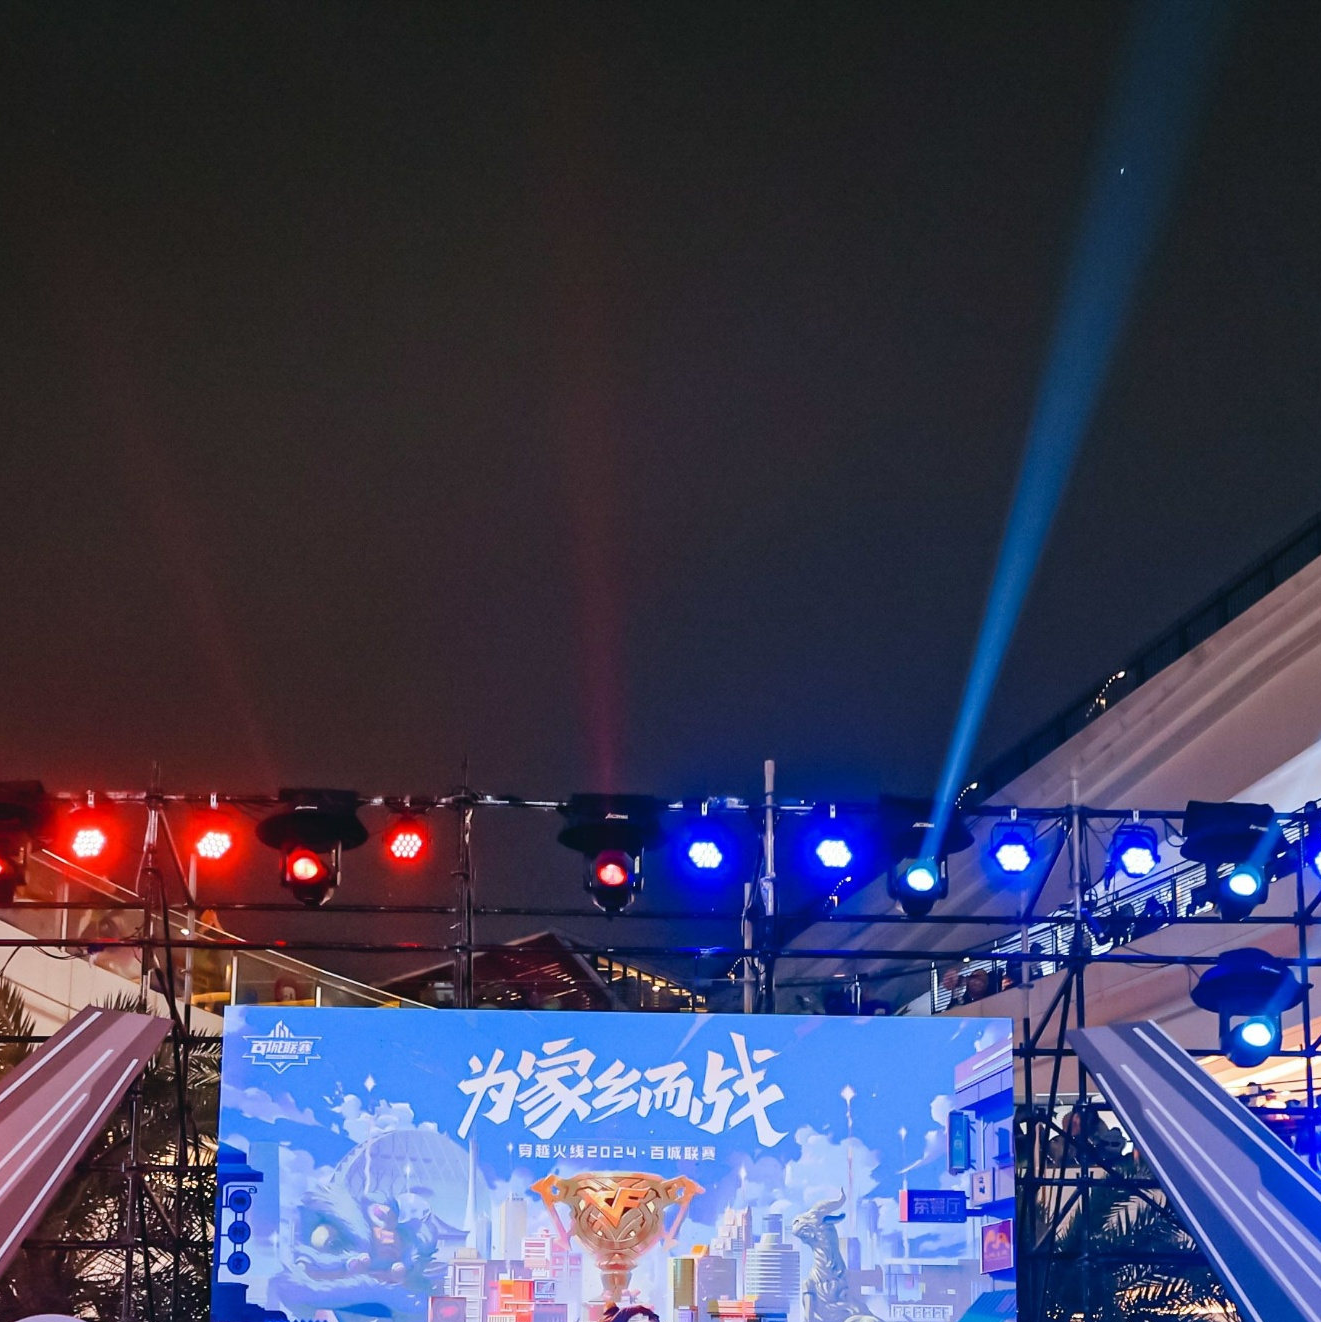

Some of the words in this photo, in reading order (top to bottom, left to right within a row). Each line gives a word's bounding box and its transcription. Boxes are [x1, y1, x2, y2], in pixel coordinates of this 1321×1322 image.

[251, 1040, 313, 1056] 百城联赛
[458, 1032, 788, 1147] 为家乡而战
